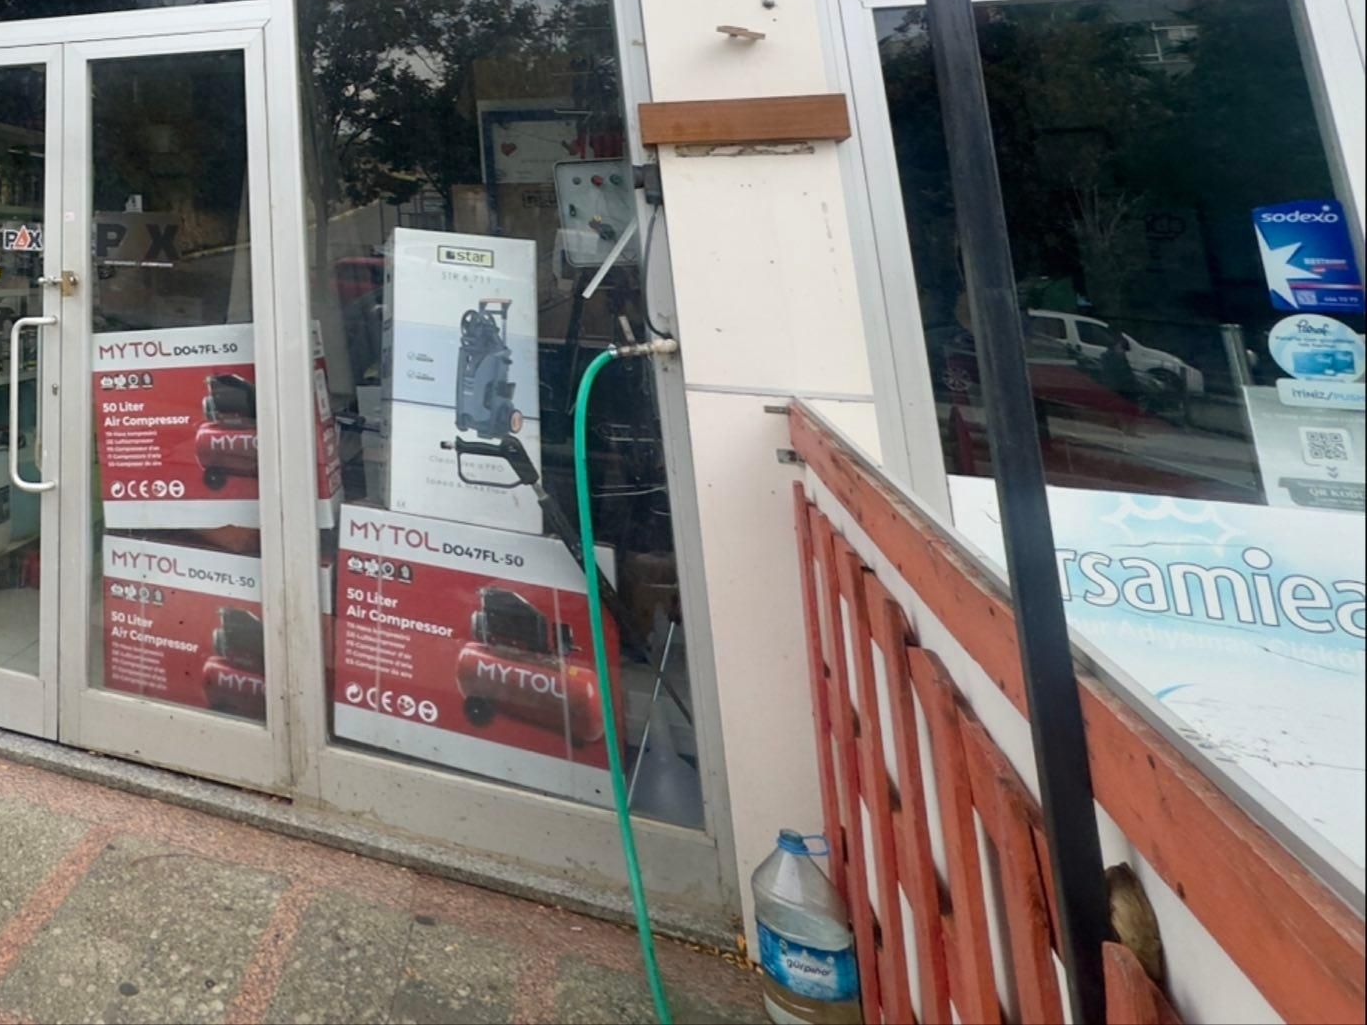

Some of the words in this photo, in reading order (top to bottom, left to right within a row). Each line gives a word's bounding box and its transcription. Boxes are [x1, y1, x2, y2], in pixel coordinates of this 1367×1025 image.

[1260, 205, 1339, 223] sodexo
[3, 224, 42, 249] PAX
[457, 250, 487, 263] star
[99, 341, 172, 360] MYTOL
[103, 402, 117, 413] 50
[119, 401, 144, 412] Liter
[104, 416, 120, 427] Air
[122, 416, 190, 427] Compressor
[350, 519, 440, 553] MYTOL
[111, 549, 186, 577] MYTOL
[346, 587, 364, 601] 50
[366, 592, 398, 608] Liter
[111, 611, 125, 623] 50
[128, 614, 153, 628] Liter
[346, 605, 367, 619] Air
[369, 609, 454, 637] Compressor
[112, 626, 128, 638] Air
[129, 629, 199, 653] Compressor
[477, 659, 566, 698] MYTOL
